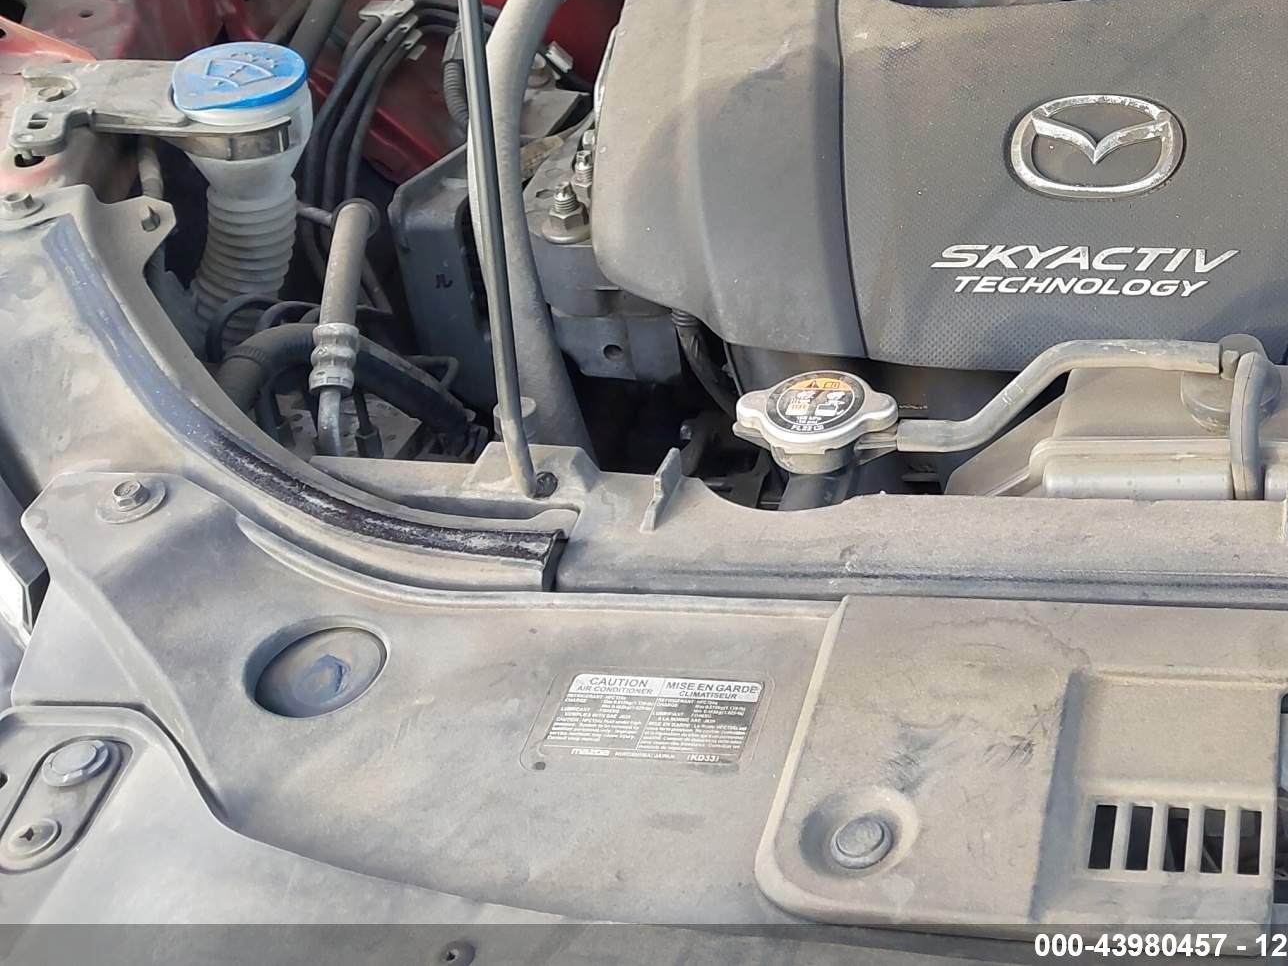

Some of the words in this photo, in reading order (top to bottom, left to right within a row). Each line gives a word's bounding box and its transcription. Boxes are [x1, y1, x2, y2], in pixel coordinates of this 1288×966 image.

[930, 244, 1240, 273] SKYACTIV
[954, 275, 1209, 297] TECHNOLOGY
[589, 677, 649, 688] CAUTION
[665, 681, 696, 691] MISE
[696, 683, 714, 692] EN
[715, 684, 758, 694] GARDE
[593, 685, 654, 695] CONDITIONER
[679, 690, 738, 700] CLIMATISEUR
